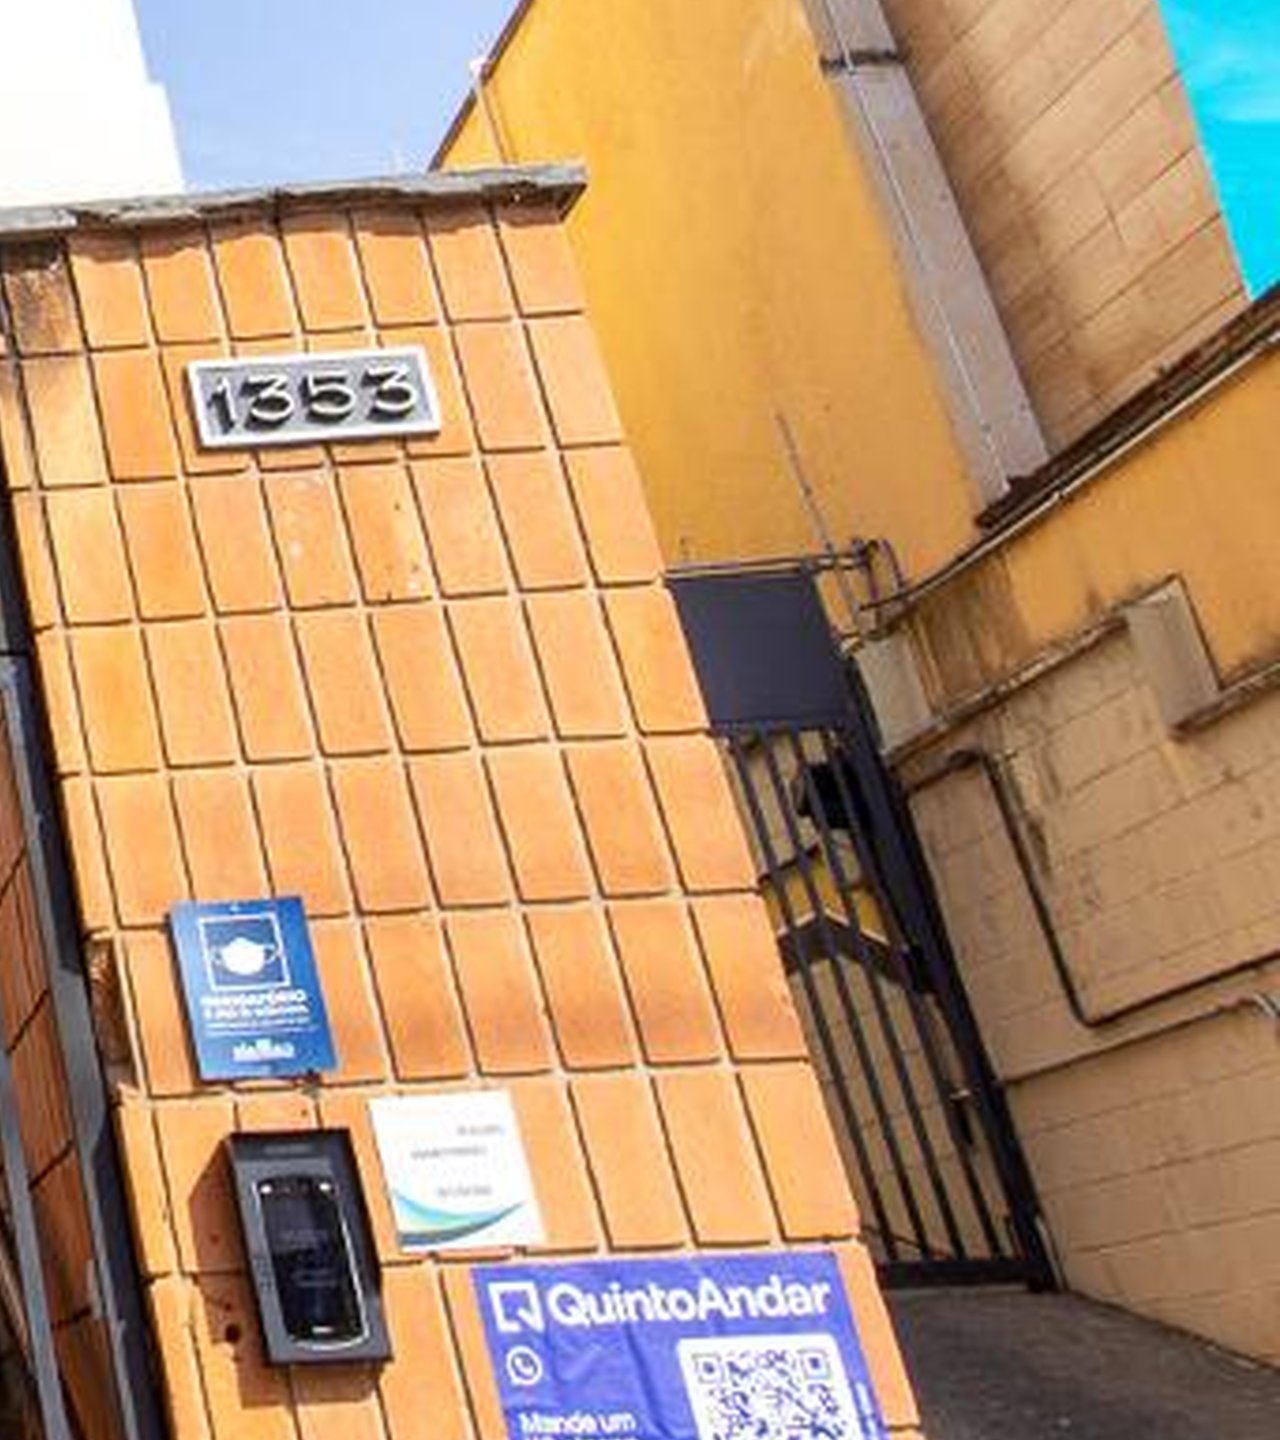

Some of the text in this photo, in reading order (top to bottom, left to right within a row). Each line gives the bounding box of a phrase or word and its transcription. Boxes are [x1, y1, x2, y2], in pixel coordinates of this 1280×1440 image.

[209, 365, 417, 430] 1353
[547, 1275, 831, 1326] QuintoAndar
[518, 1411, 637, 1435] Mande um
